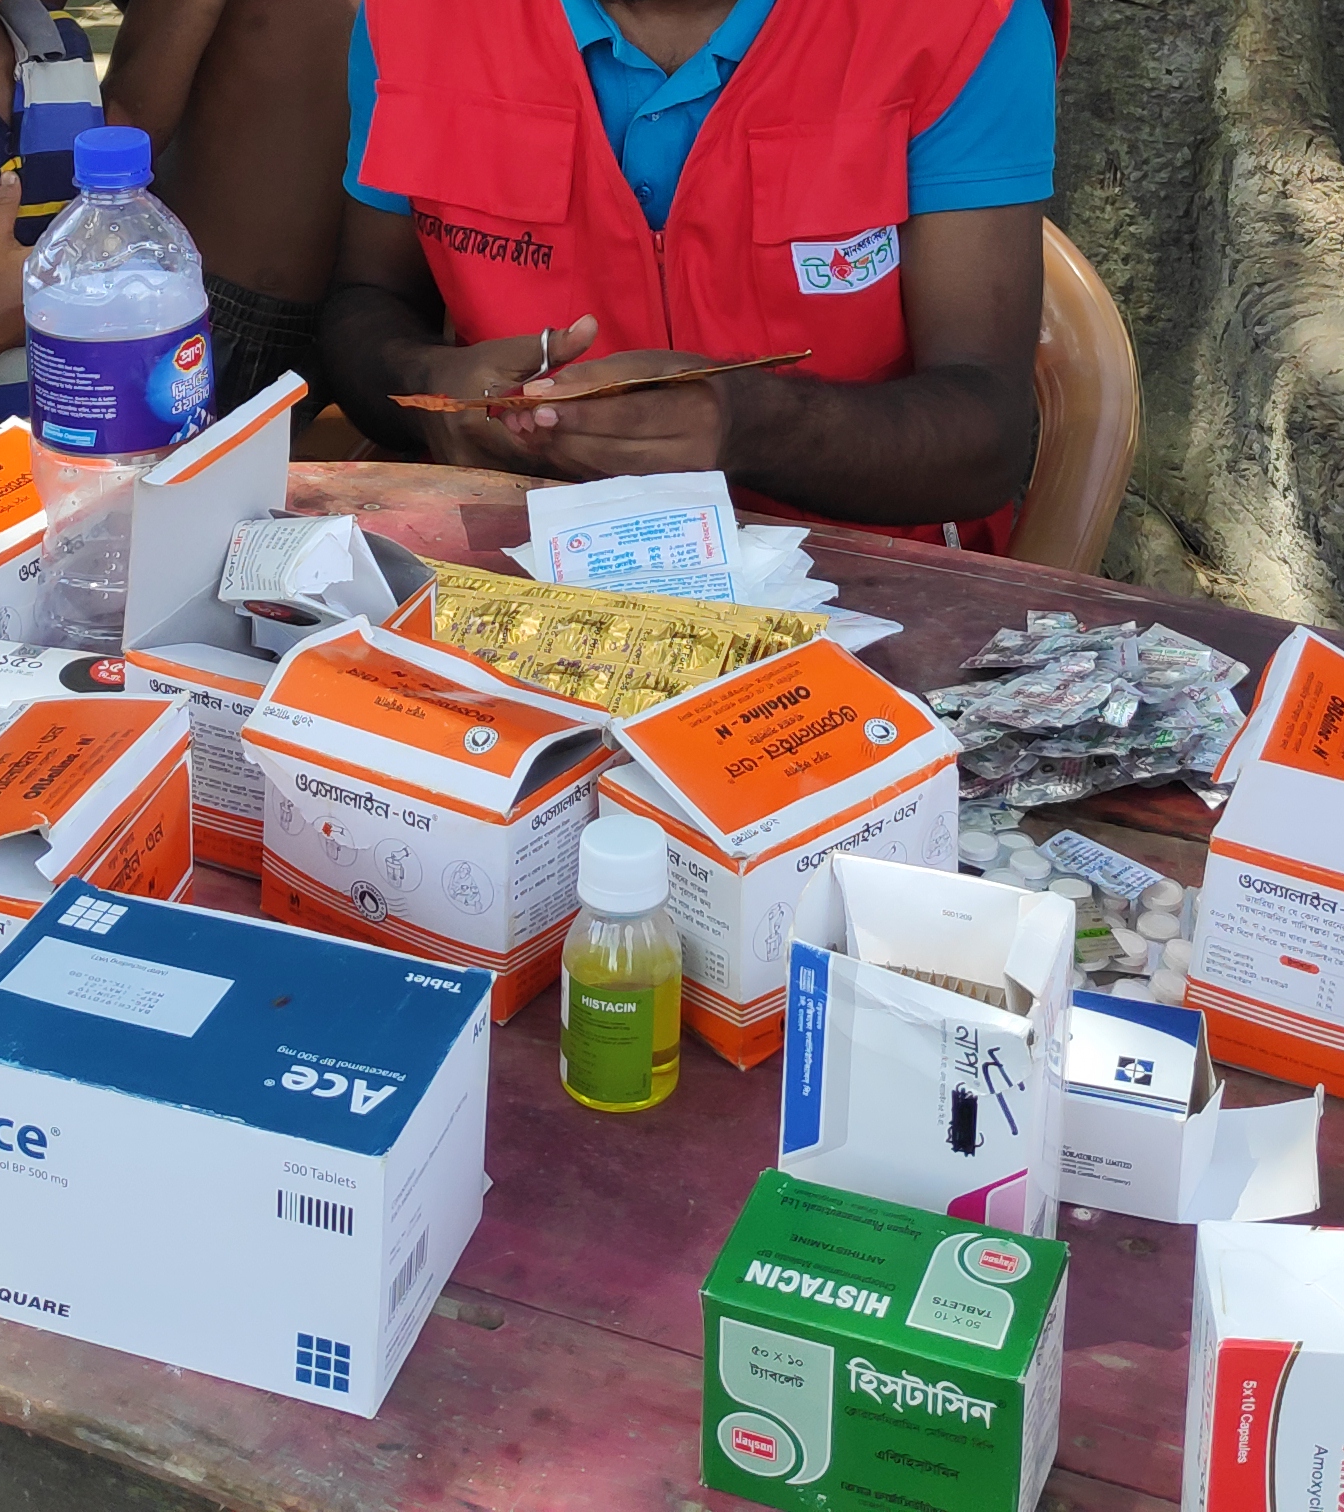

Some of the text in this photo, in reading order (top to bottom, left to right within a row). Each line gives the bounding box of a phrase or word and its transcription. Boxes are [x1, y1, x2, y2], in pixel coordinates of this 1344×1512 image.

[511, 231, 554, 270] জীবন
[178, 341, 204, 366] প্রাণ
[224, 527, 247, 591] Veridin
[97, 659, 126, 672] ১৫
[404, 972, 462, 994] Tablet
[581, 994, 637, 1013] HISTACIN
[276, 1045, 408, 1082] Paracetamol BP 500 mg
[954, 1025, 979, 1078] নাপা
[280, 1064, 398, 1116] Ace
[12, 1161, 27, 1175] BP
[28, 1166, 49, 1181] 500
[49, 1173, 69, 1189] mg
[282, 1160, 358, 1190] 500 Tablets
[800, 1199, 885, 1231] Pharmaceuticals
[788, 1232, 886, 1266] ANTIHISTAMINE
[744, 1259, 892, 1319] HISTACIN
[931, 1296, 993, 1319] TABLETS
[933, 1309, 982, 1330] 50 X 10
[750, 1344, 805, 1368] ৫০ X ১০
[748, 1360, 805, 1389] ট্যাবলেট
[845, 1356, 999, 1430] হিস্টাসিন
[734, 1428, 775, 1455] Jayson
[1236, 1412, 1254, 1465] Capsules
